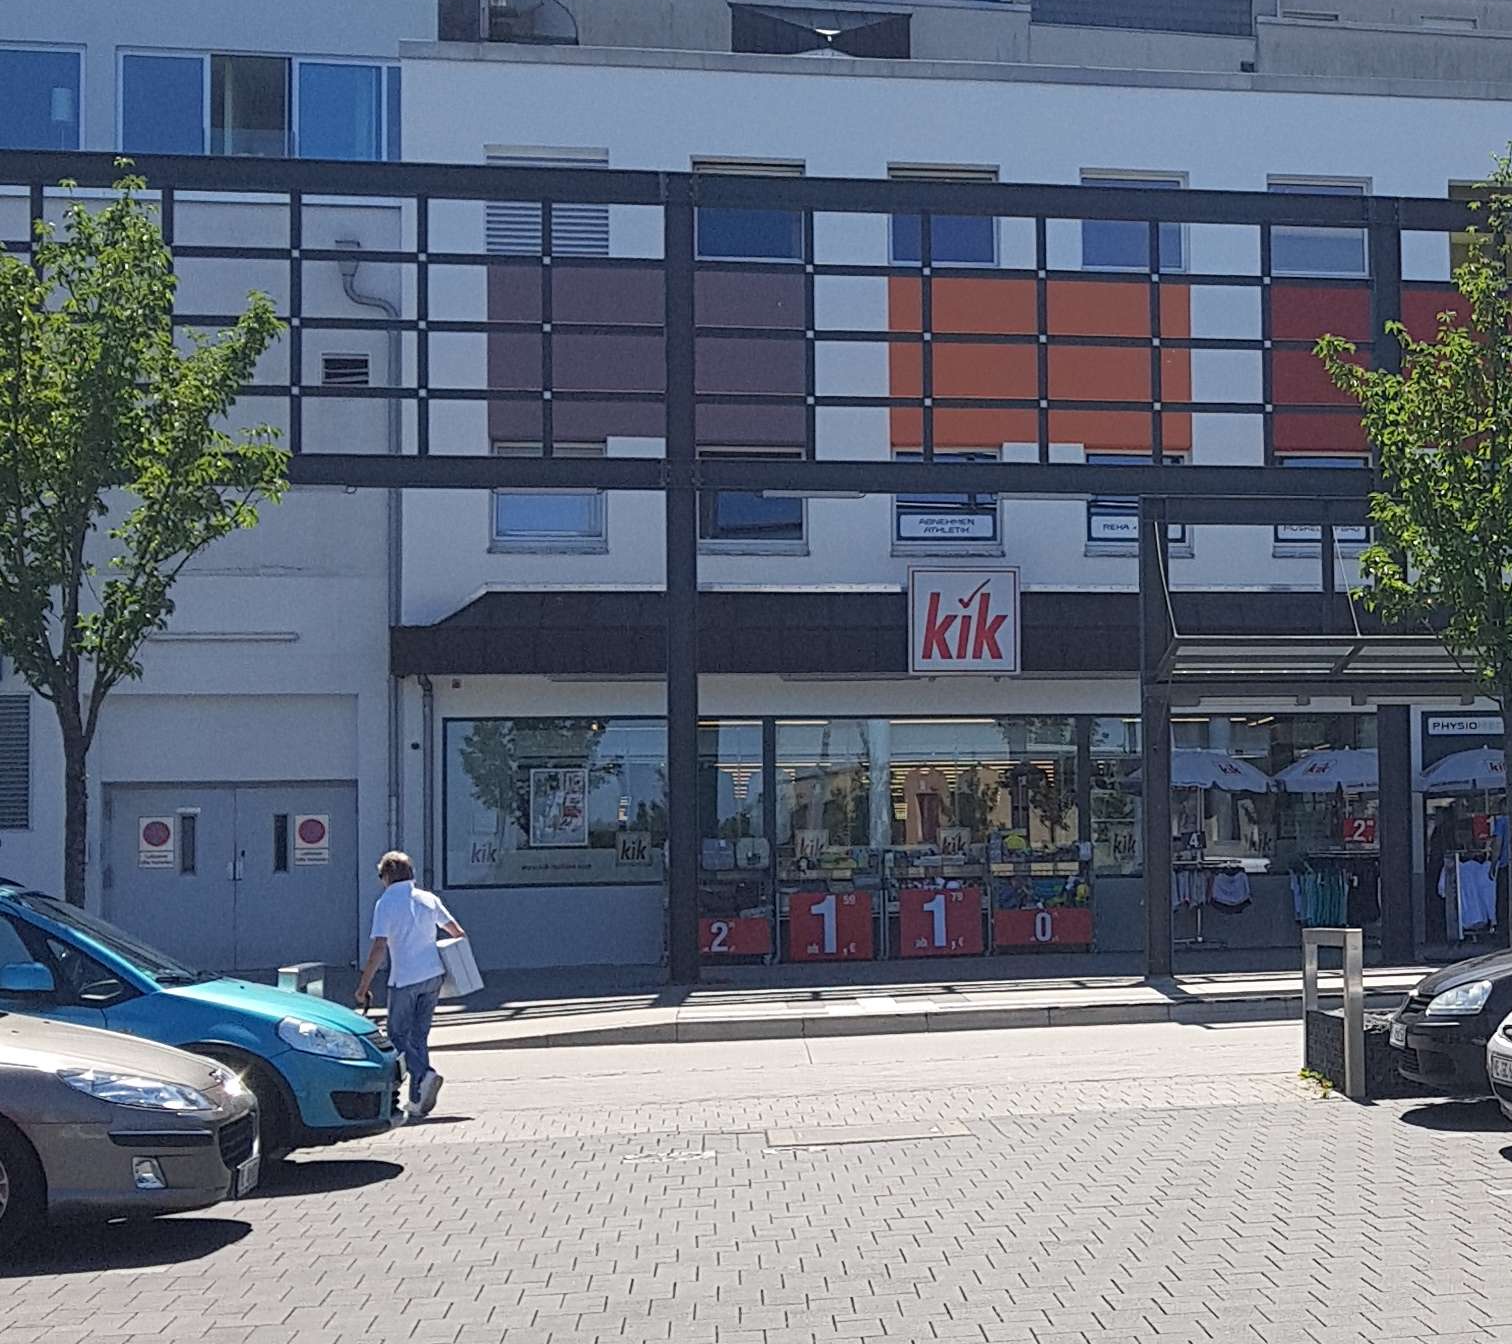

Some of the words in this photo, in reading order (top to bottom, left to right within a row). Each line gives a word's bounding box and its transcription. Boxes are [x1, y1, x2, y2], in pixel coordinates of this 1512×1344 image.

[918, 518, 975, 526] ABNEHMEN
[923, 526, 971, 534] ATHLETIK
[1102, 523, 1130, 531] REHA
[921, 579, 1009, 660] kik
[471, 839, 497, 864] kik
[620, 839, 647, 861] kik
[810, 894, 837, 954] 1
[922, 894, 947, 948] 1
[1034, 911, 1053, 943] 0
[710, 921, 729, 953] 2
